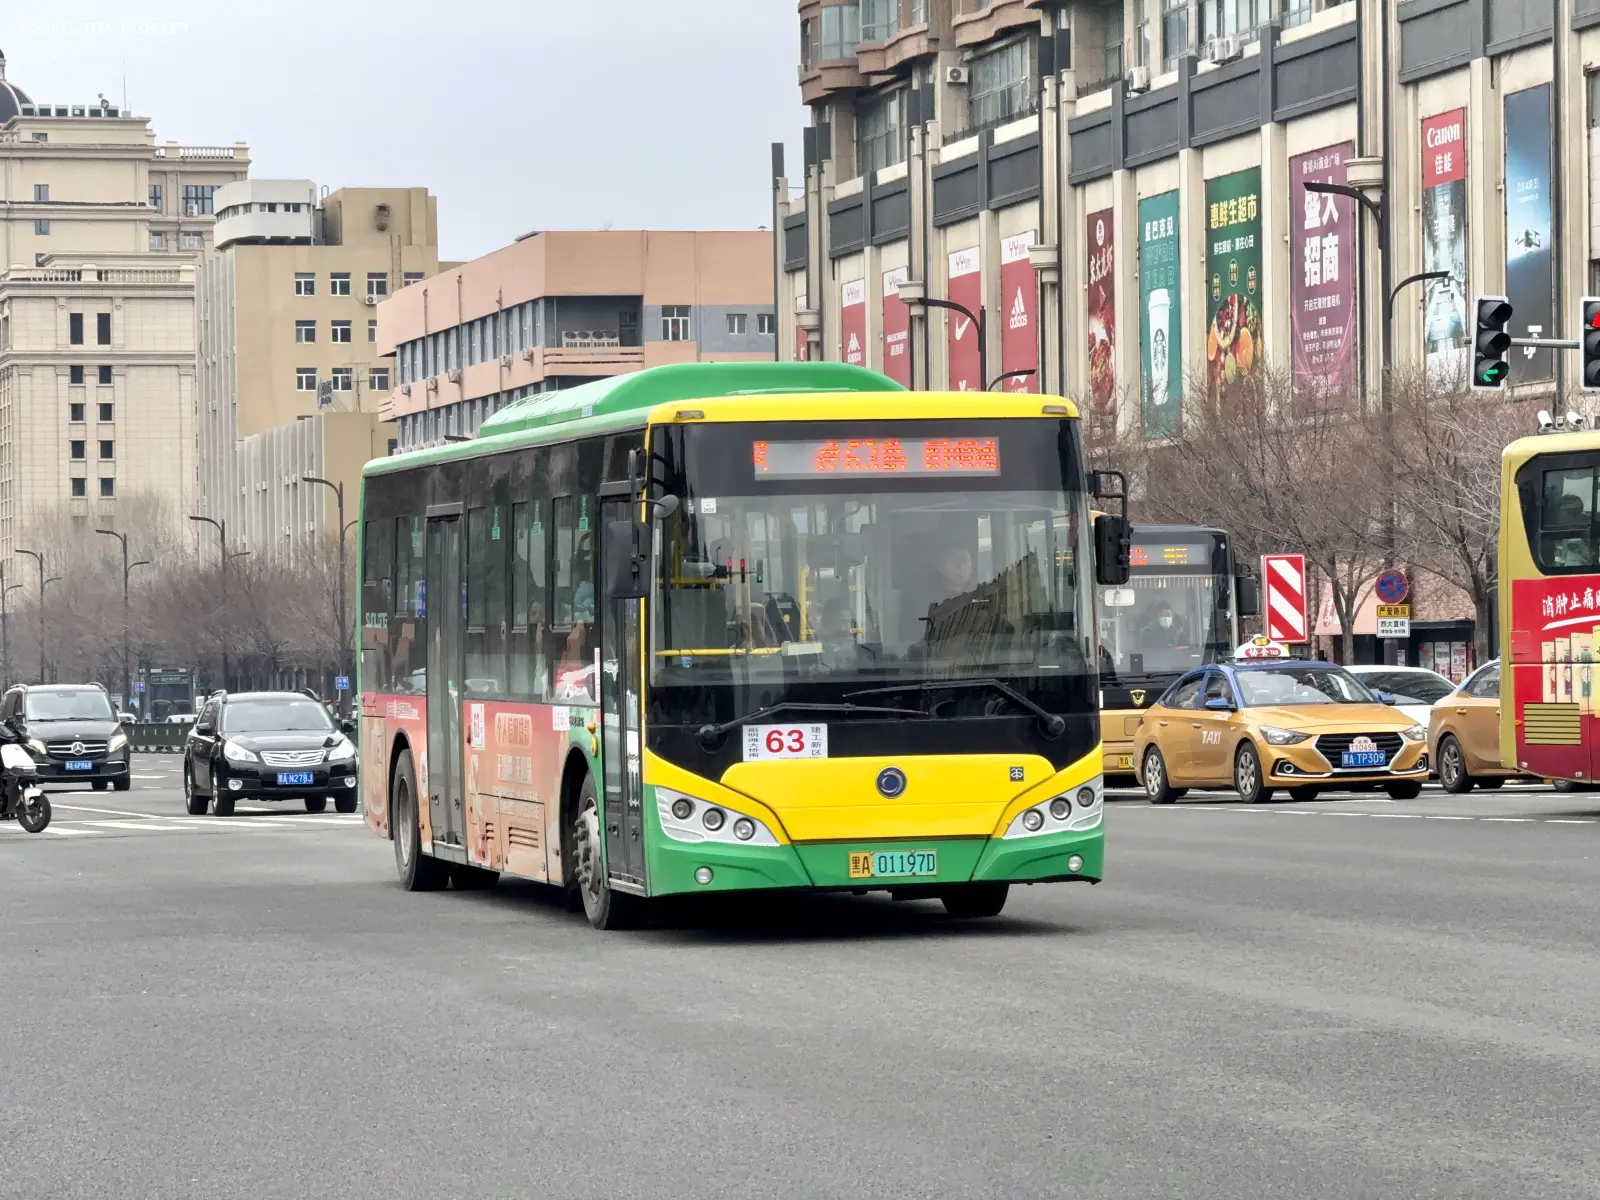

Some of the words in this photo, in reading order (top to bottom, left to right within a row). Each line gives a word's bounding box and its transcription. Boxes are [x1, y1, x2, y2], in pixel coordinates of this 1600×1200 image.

[1426, 122, 1461, 149] Canon
[1434, 151, 1453, 175] 佳能
[1304, 175, 1339, 230] 盛大
[1304, 232, 1339, 288] 招商
[1009, 313, 1028, 329] adidas
[1380, 620, 1406, 628] 西大直街
[766, 729, 805, 753] 63
[810, 726, 823, 756] 建工新区
[1201, 730, 1222, 745] TAXI
